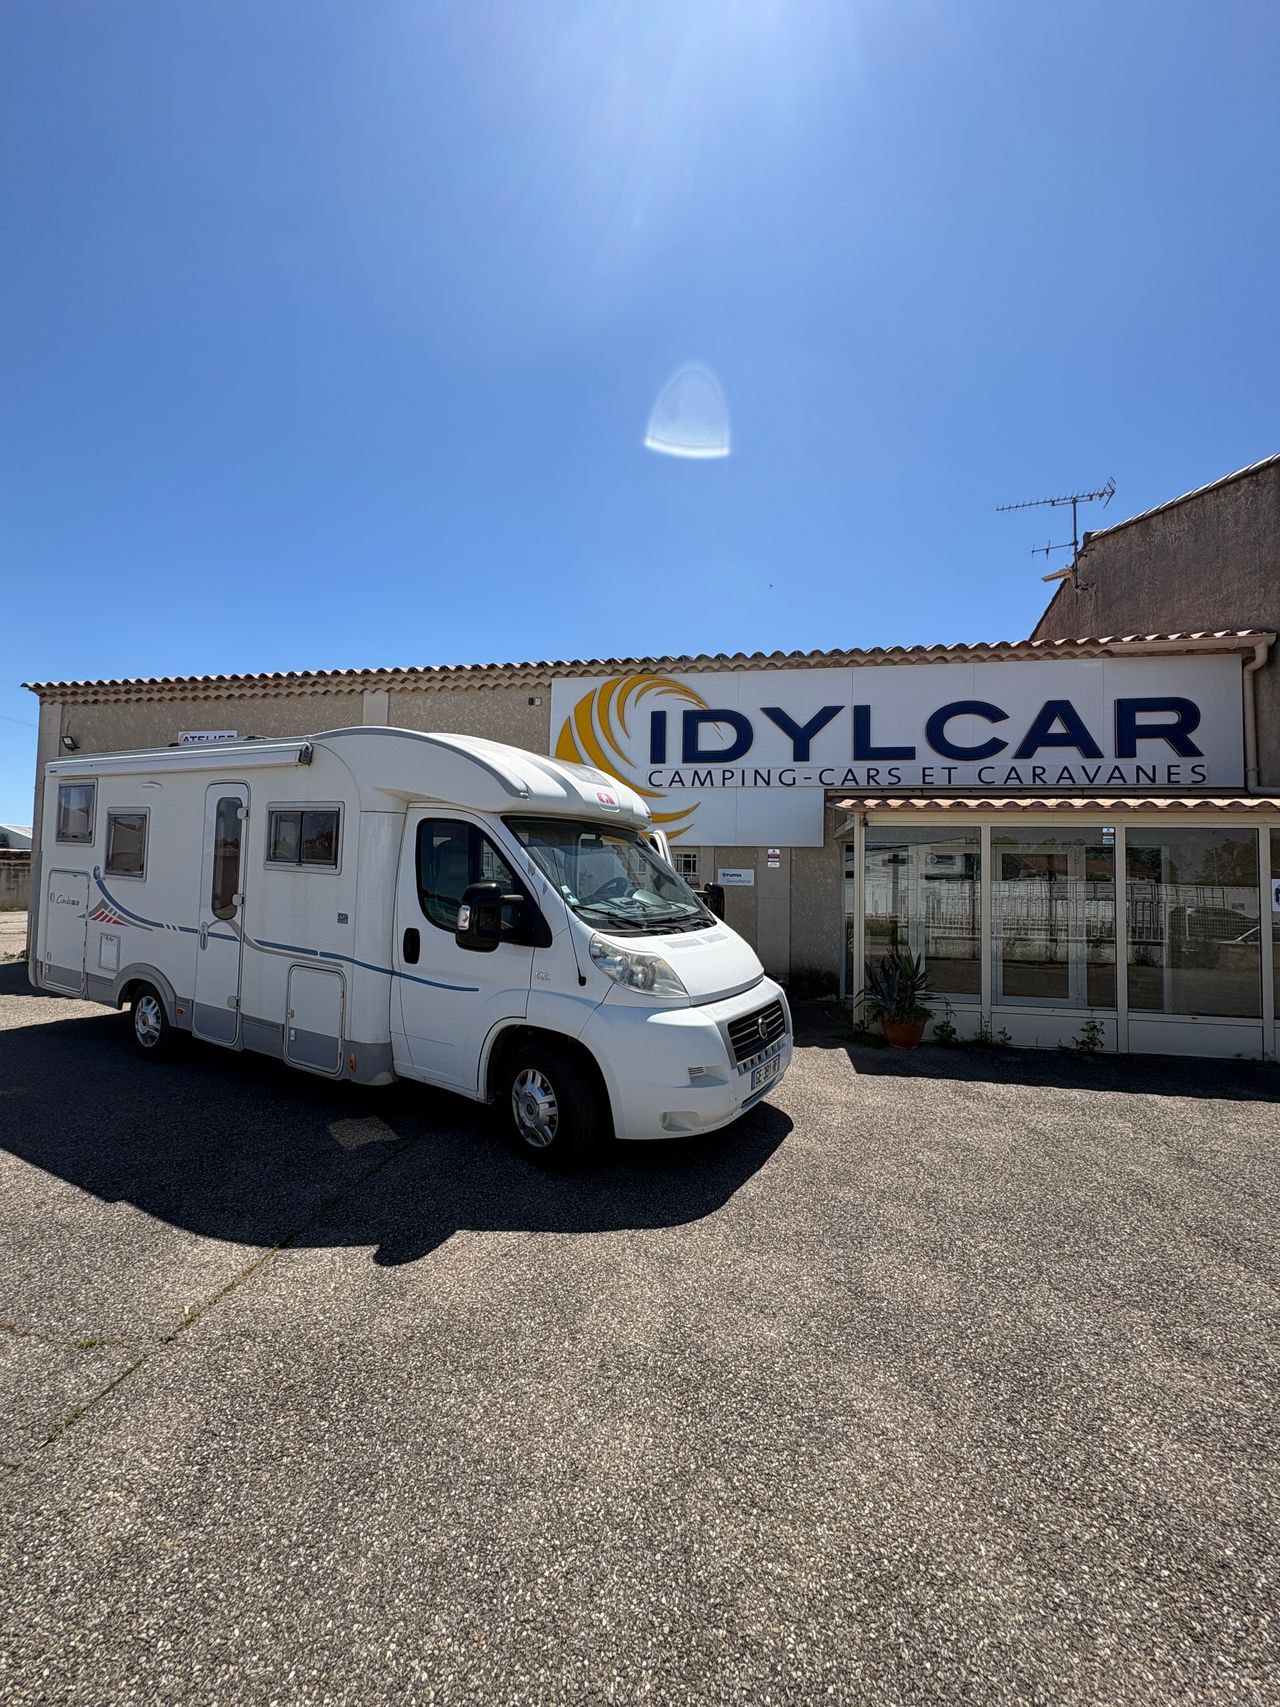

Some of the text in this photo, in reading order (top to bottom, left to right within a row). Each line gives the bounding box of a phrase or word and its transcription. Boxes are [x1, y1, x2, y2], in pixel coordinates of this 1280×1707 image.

[650, 697, 1205, 764] IDYLCAR
[648, 764, 1207, 787] CAMPING-CARS ET CARAVANES
